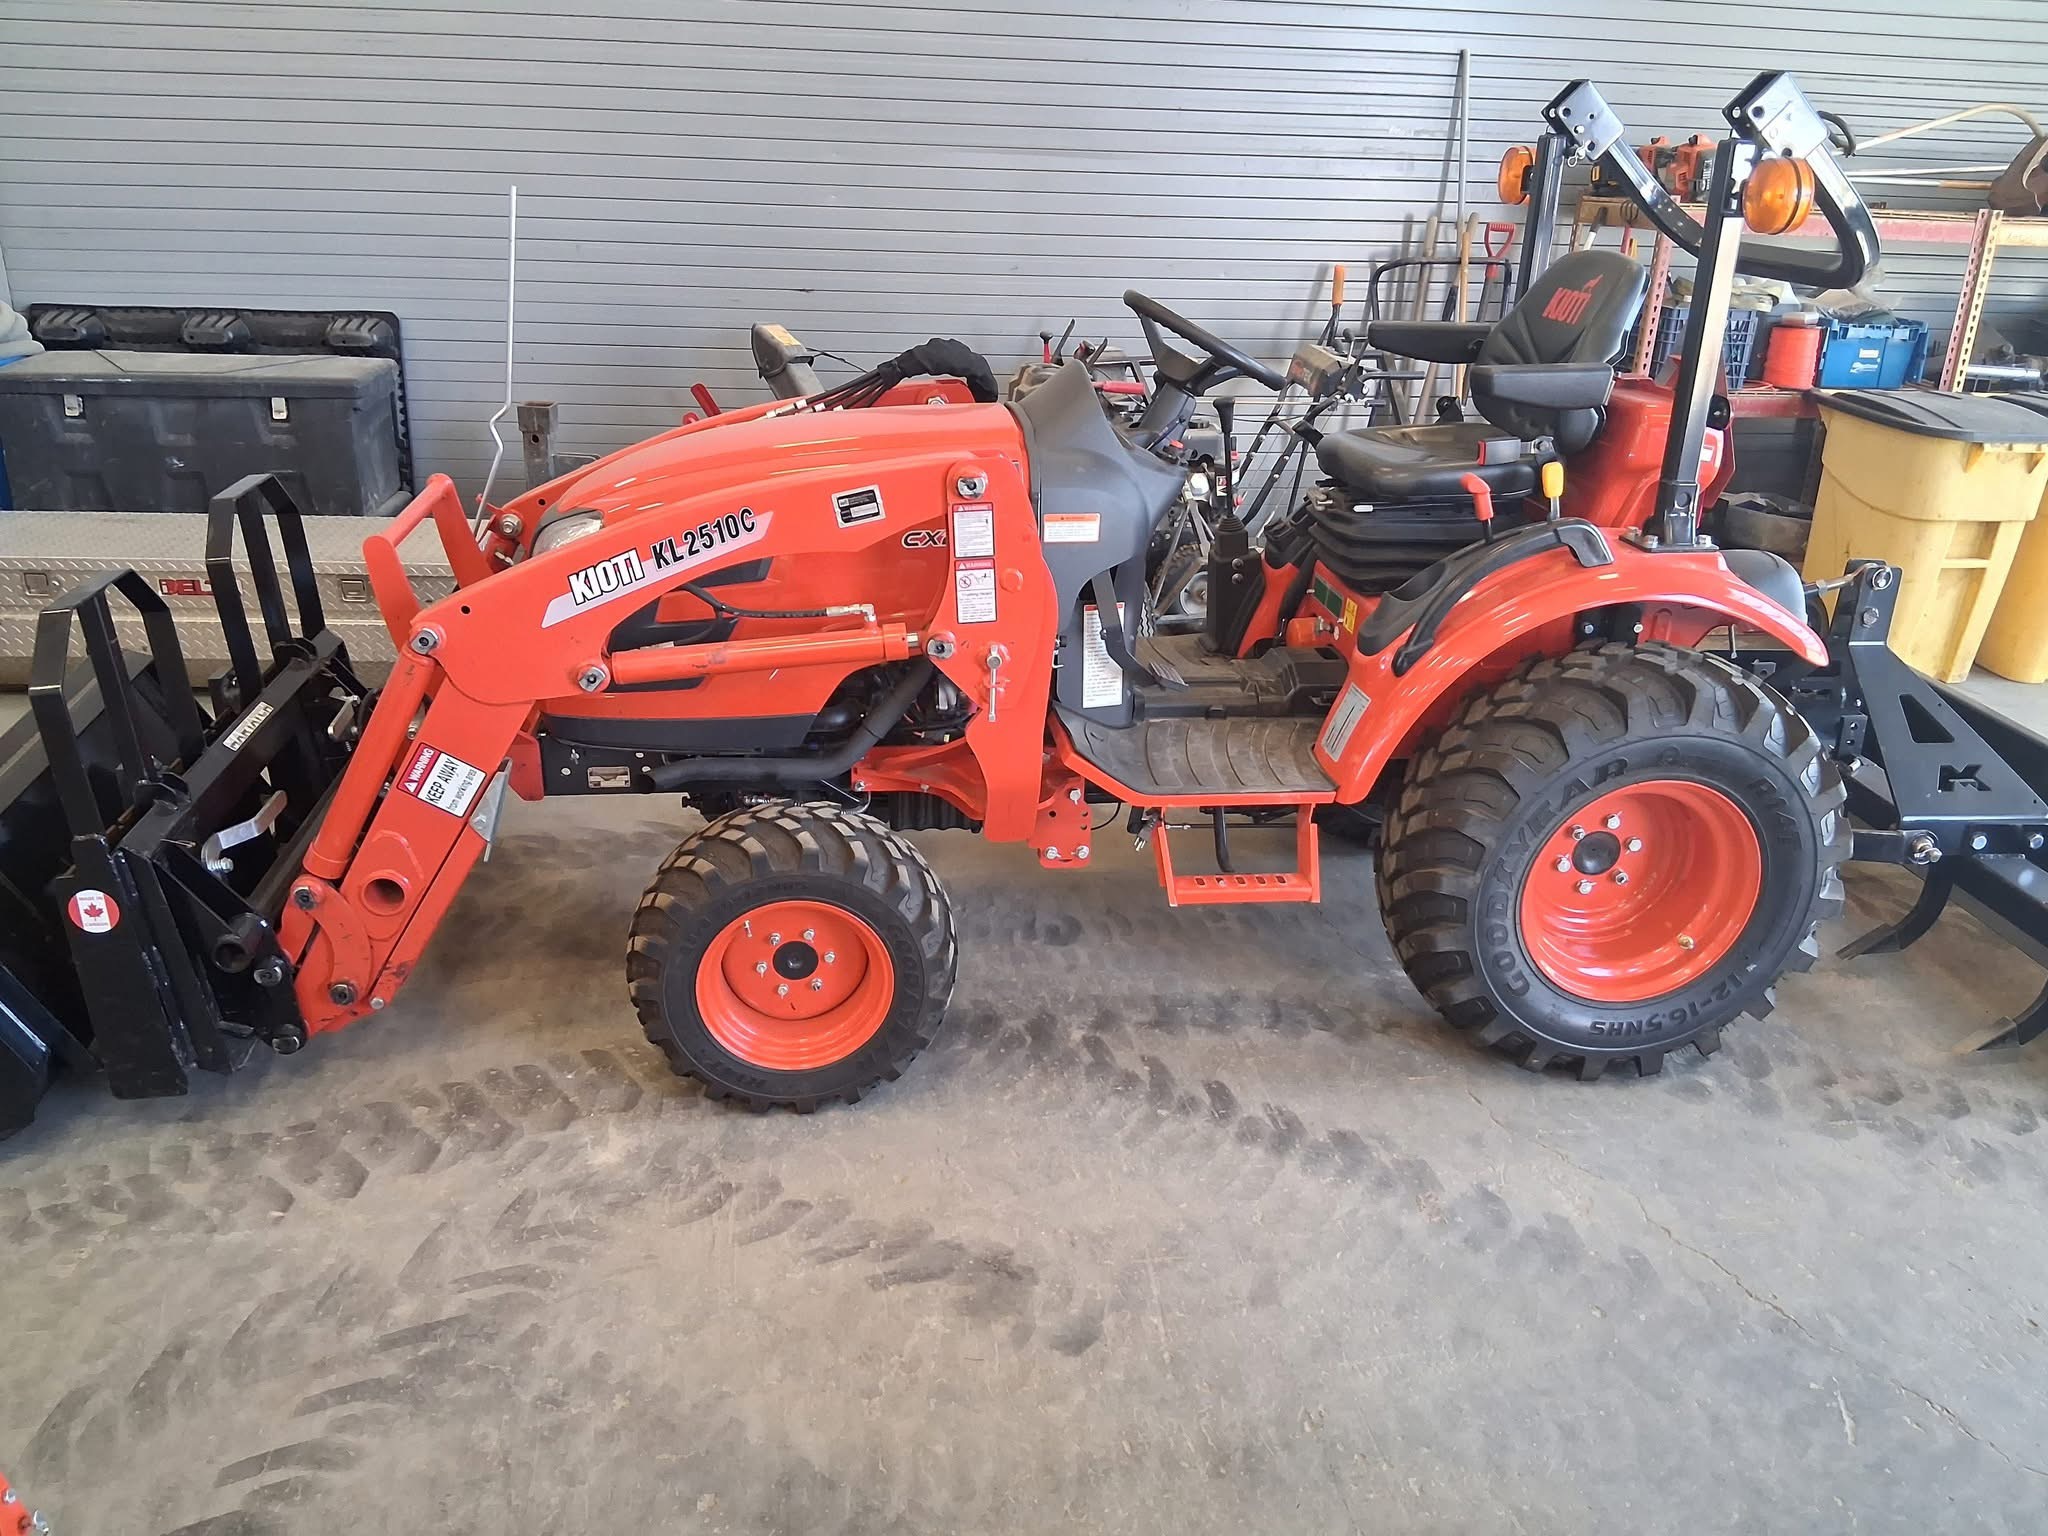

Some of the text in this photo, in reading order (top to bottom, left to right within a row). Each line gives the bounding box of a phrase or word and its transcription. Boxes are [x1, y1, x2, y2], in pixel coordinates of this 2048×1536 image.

[650, 507, 757, 572] KL2510C
[568, 547, 646, 606] KIOTI
[408, 747, 435, 781] WARNING
[425, 757, 460, 804] KEEP AWAY
[446, 769, 478, 812] from working area
[1487, 757, 1628, 997] GOODYEAR
